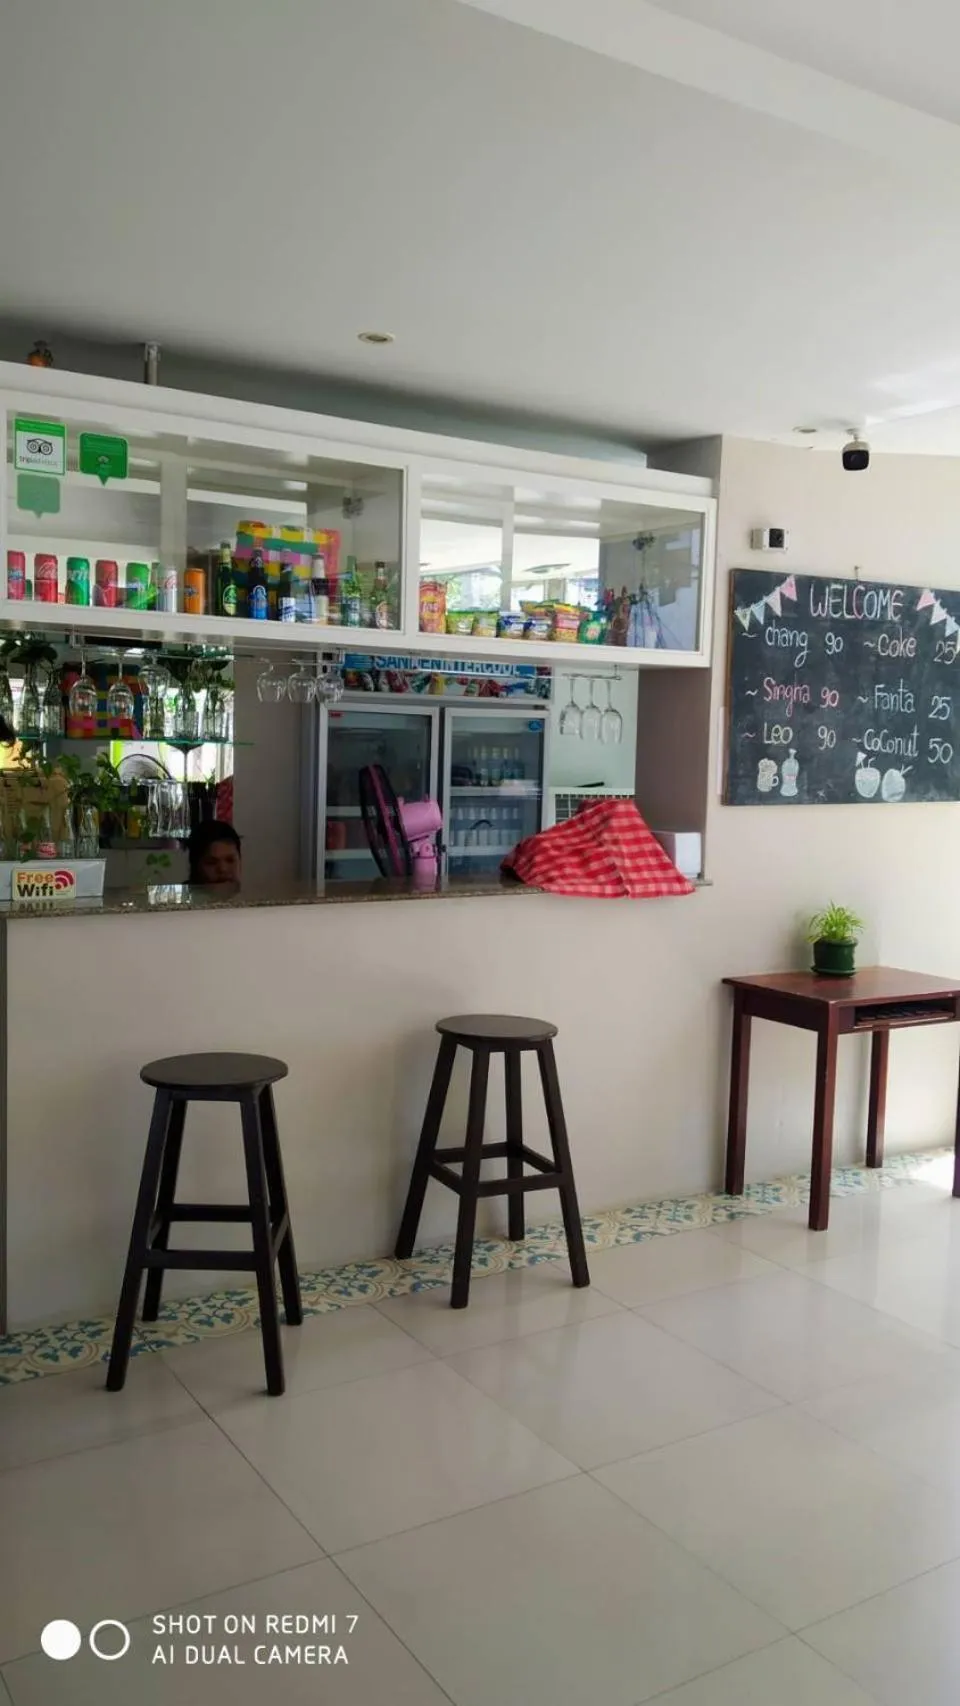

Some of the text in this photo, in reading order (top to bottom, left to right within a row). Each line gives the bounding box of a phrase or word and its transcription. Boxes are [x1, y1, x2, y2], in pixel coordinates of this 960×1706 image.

[810, 583, 903, 621] WELCOME
[825, 632, 843, 655] 90
[878, 627, 955, 665] Coke 25
[763, 674, 839, 717] Singha 90
[874, 679, 951, 720] Fanta 25
[818, 725, 836, 750] 90
[928, 738, 953, 764] 50
[17, 872, 54, 884] Free
[17, 884, 54, 897] Wifi
